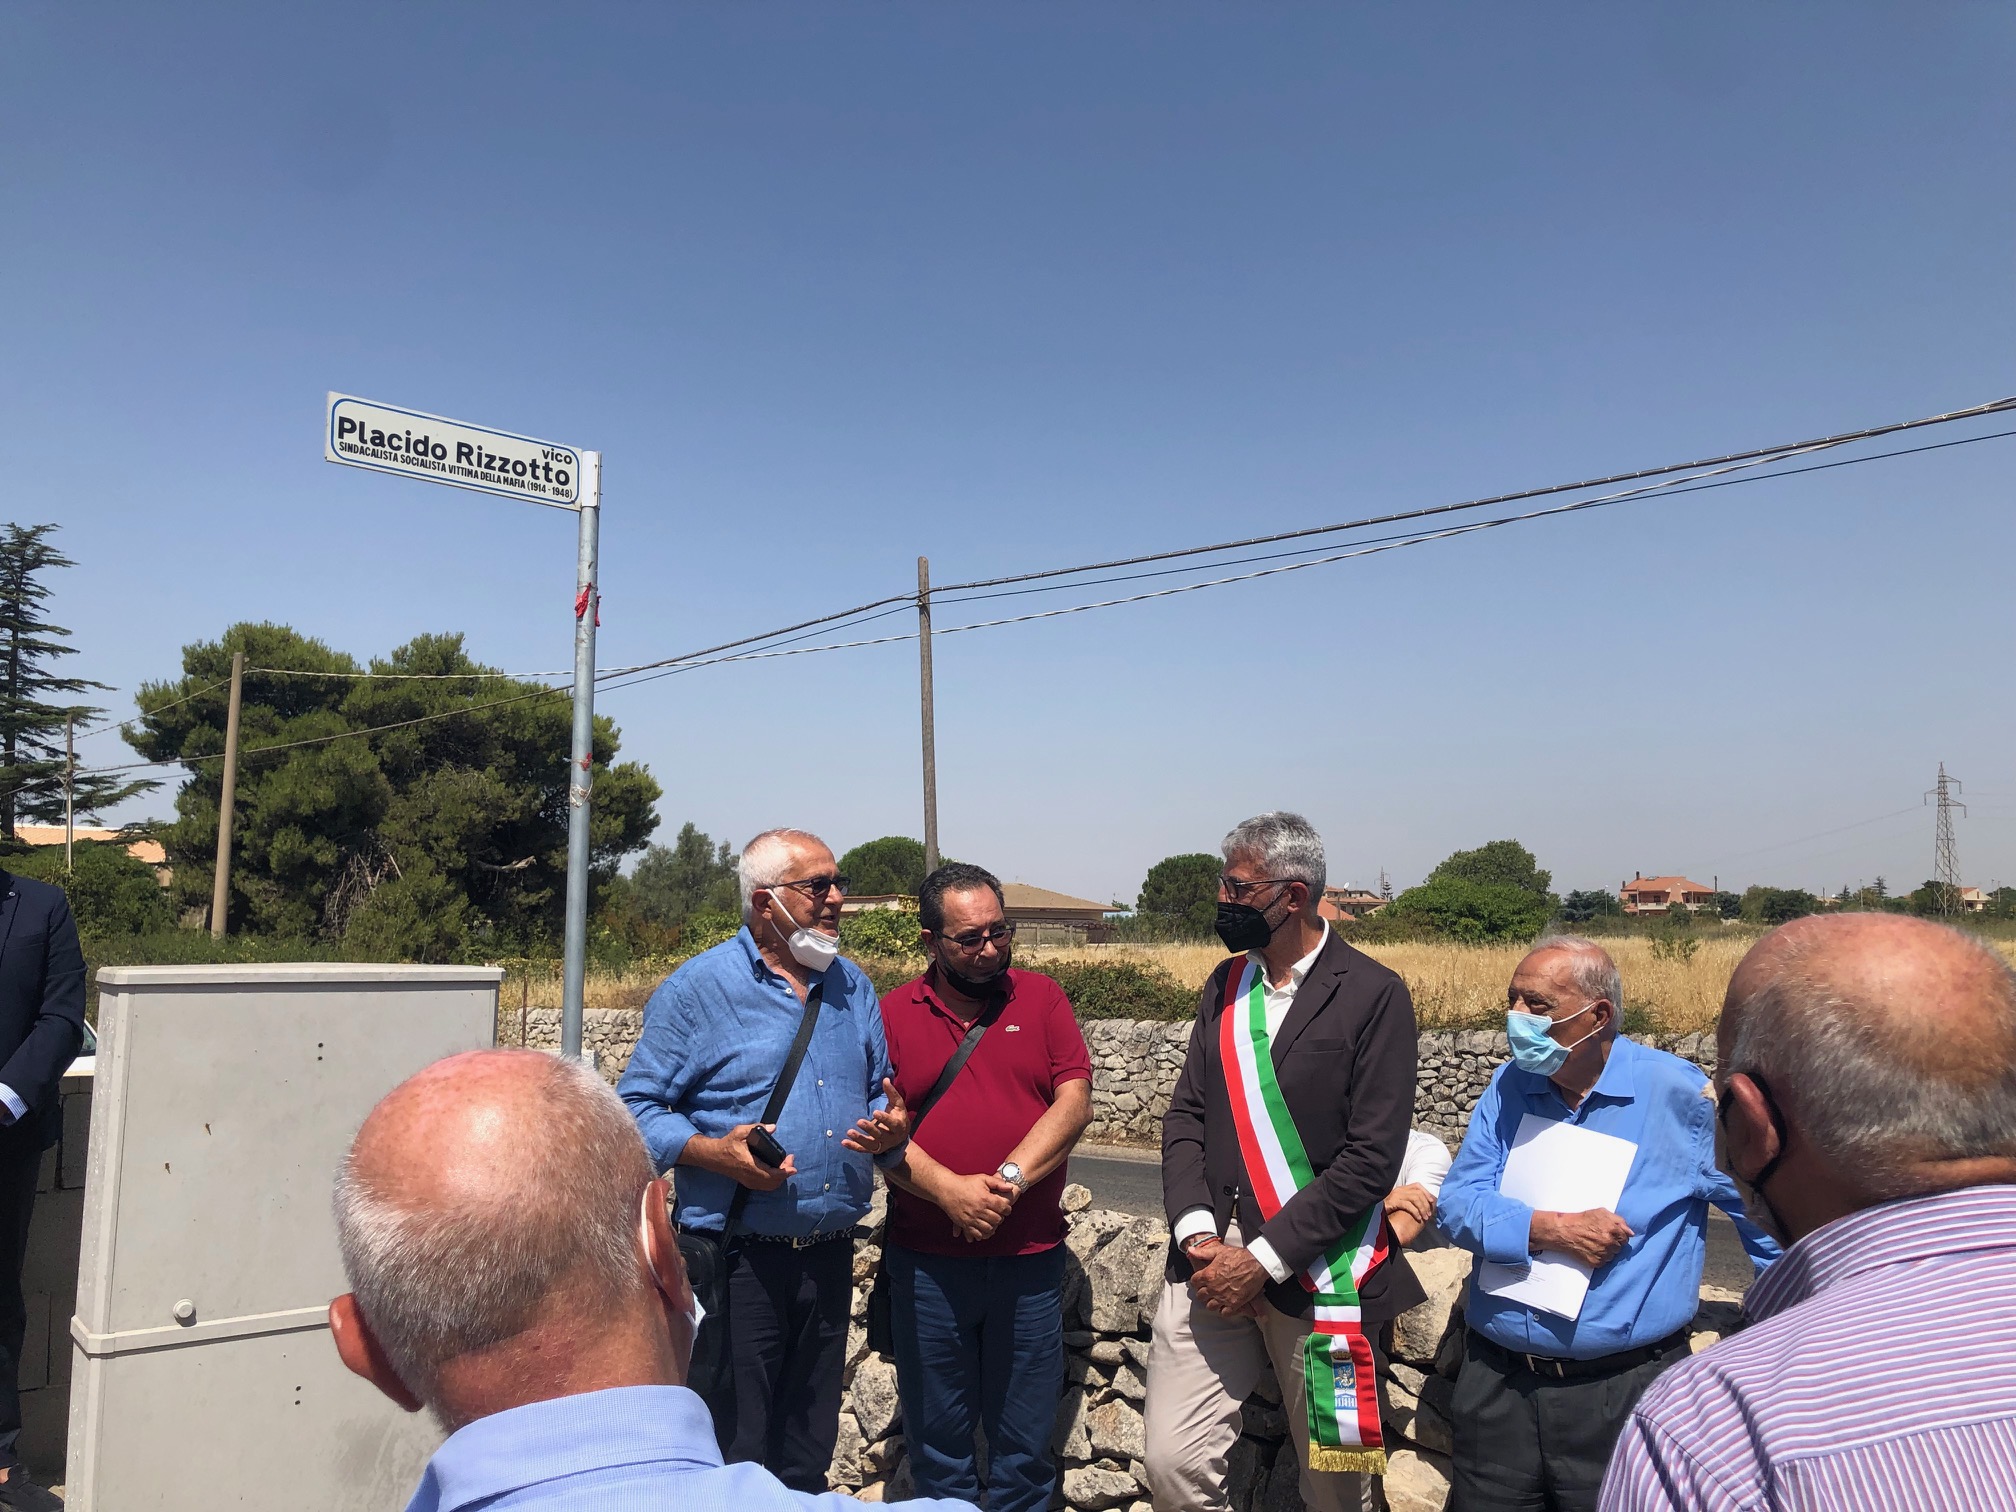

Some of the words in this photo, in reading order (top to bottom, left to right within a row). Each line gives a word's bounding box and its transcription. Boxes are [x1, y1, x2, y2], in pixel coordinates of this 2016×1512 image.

[337, 415, 448, 461] Placido
[455, 441, 570, 487] Rizzotto
[338, 441, 399, 463] SINDACALISTA
[400, 453, 447, 473] SOCIALISTA
[448, 464, 479, 480] VITTIMA
[480, 470, 501, 485] DELLA
[502, 475, 526, 490] MAFIA
[527, 481, 547, 494] (1914
[552, 486, 573, 500] 1948)
[541, 447, 573, 465] vico
